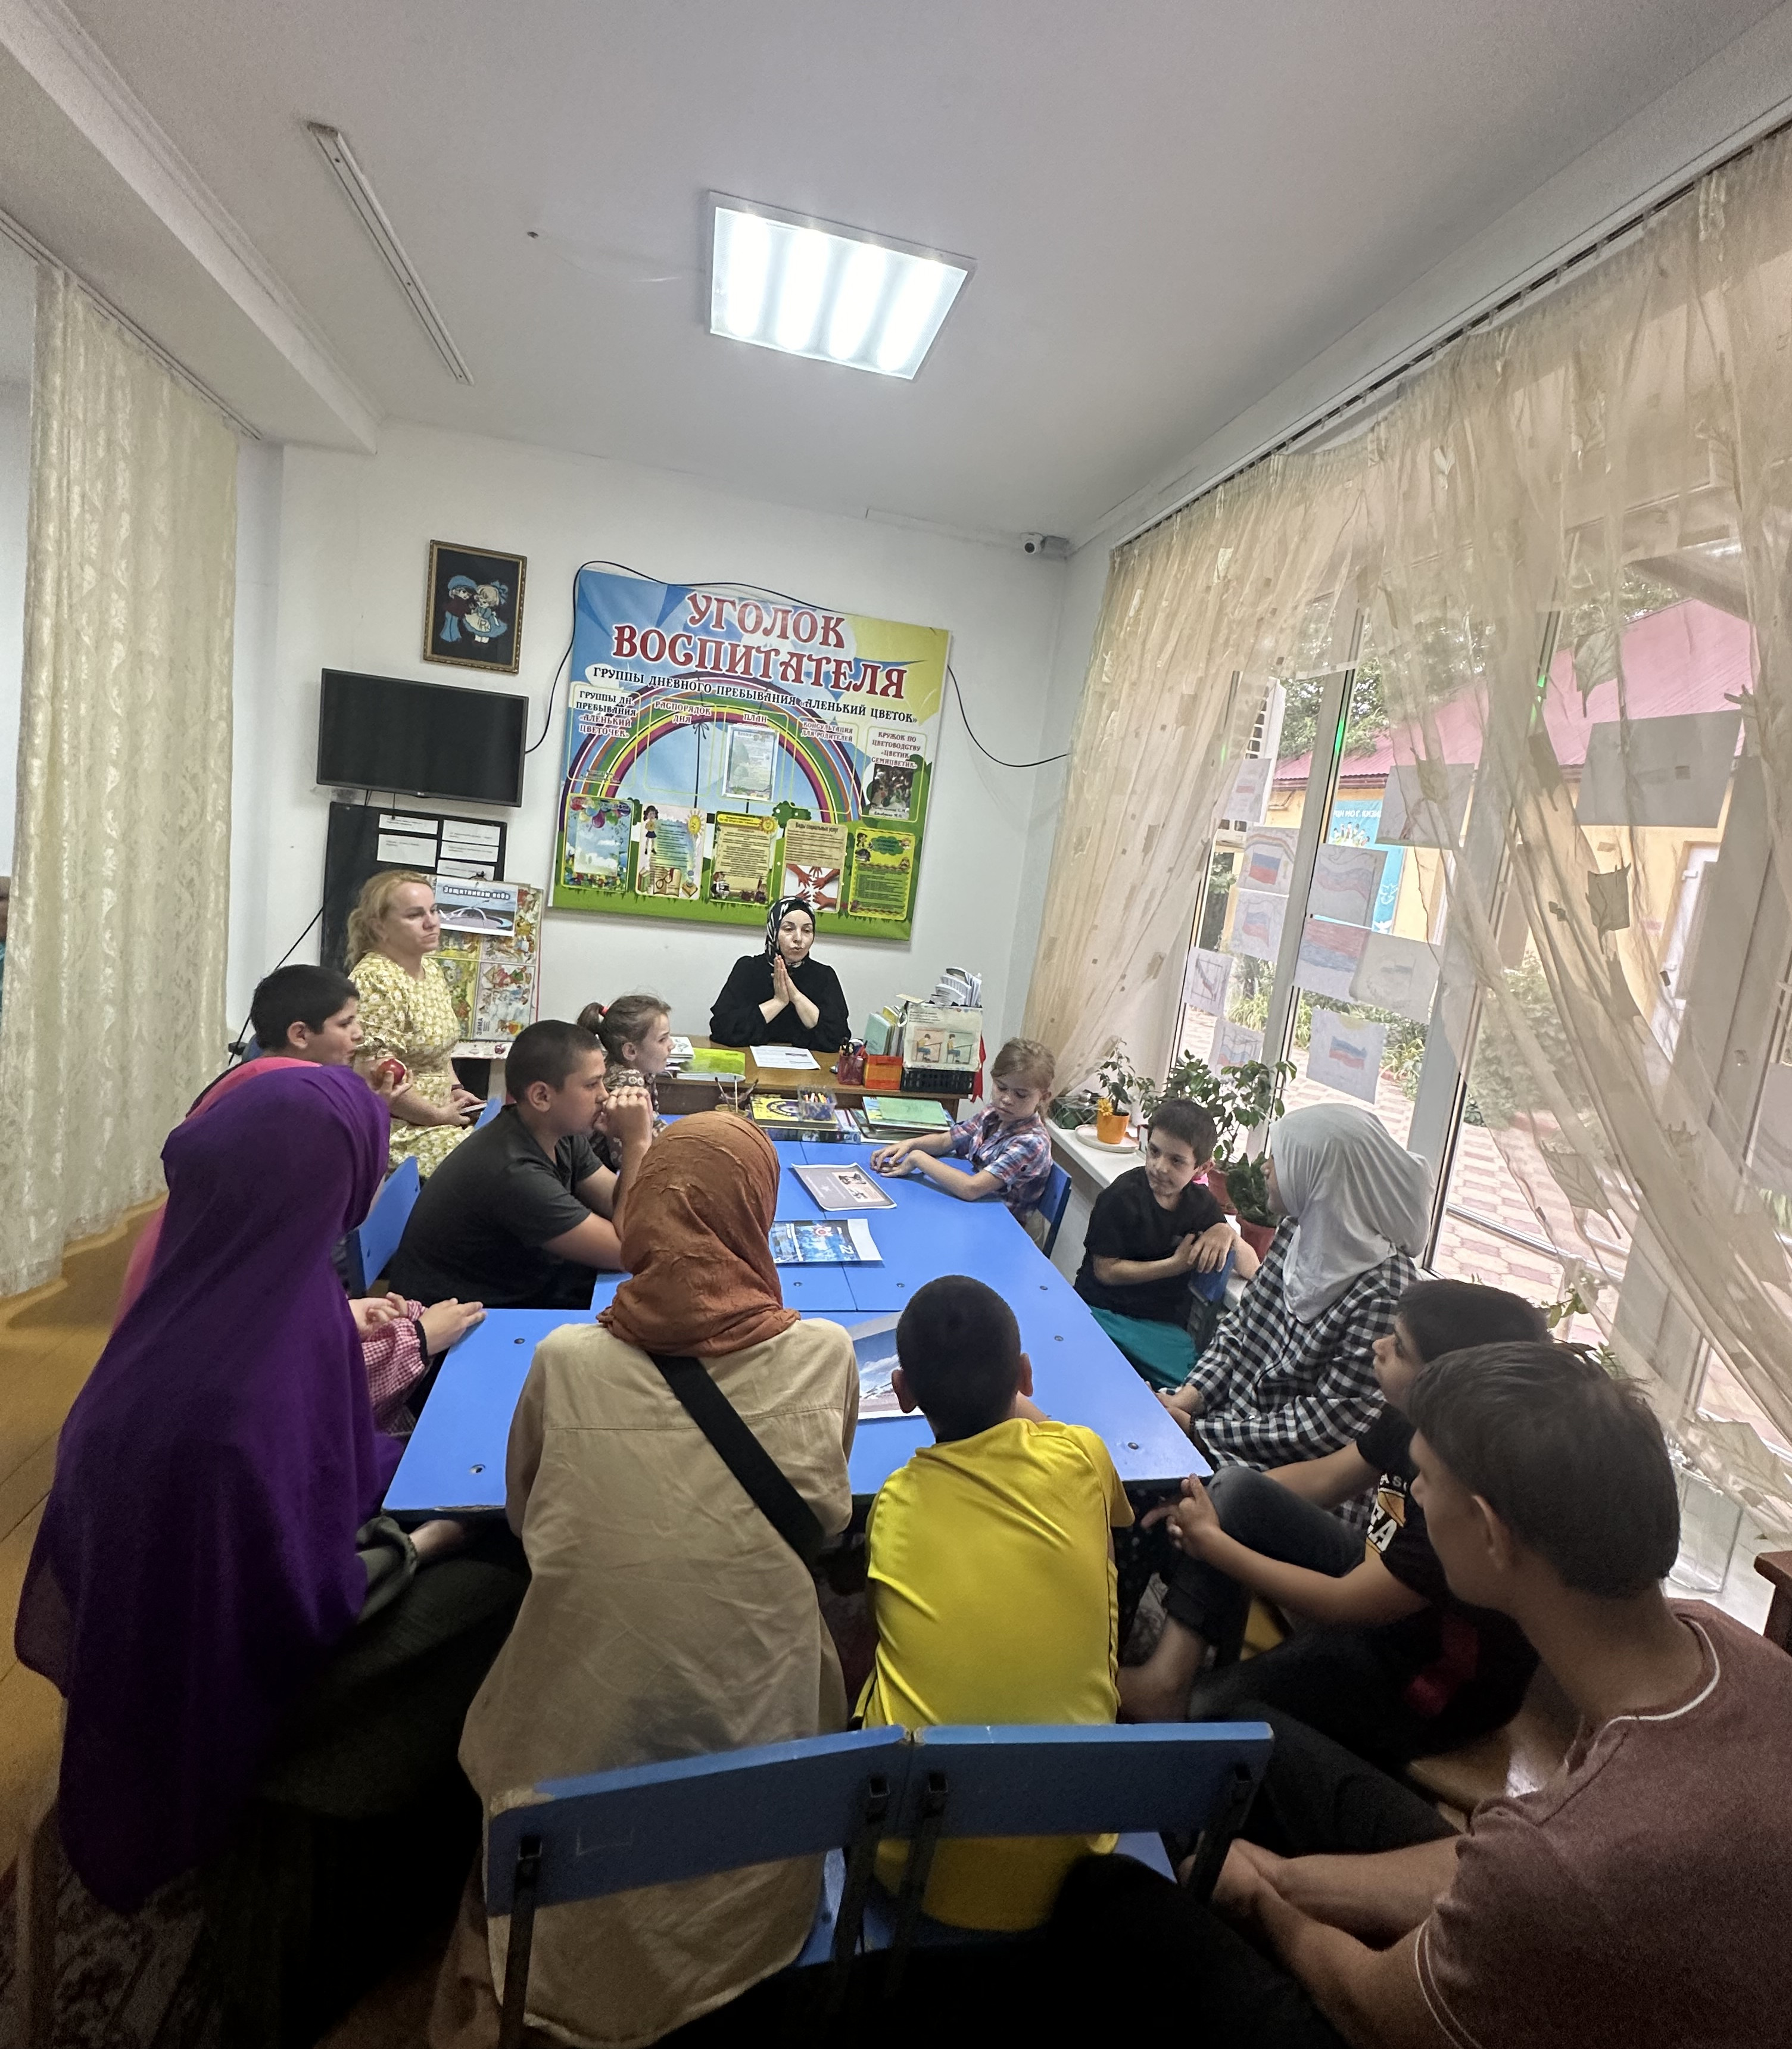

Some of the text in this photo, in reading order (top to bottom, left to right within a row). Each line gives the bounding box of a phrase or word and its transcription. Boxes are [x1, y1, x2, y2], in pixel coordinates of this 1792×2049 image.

[687, 593, 845, 648] УГОЛОК
[612, 625, 907, 699] ВОСПИТАТЕЛЯ
[579, 691, 634, 705] ГРУППЫ ДН.
[593, 667, 917, 723] ГРУППЫ ДНЕВНОГО ПРЕБЫВАНИЯ «АЛЕНЬКИЙ ЦВЕТОК»
[576, 701, 637, 716] ПРЕБЫВАНИЯ
[655, 701, 711, 715] РАСПОРЯДОК
[579, 714, 631, 727] «АЛЕНЬКИЙ
[674, 715, 691, 723] ДНЯ
[744, 715, 767, 723] ПЛАН
[579, 725, 629, 738] ЦВЕТОЧЕК»
[816, 732, 853, 742] РОДИТЕЛЕЙ
[878, 731, 905, 741] КРУЖОК
[872, 739, 921, 751] ЦВЕТОВОДСТВУ
